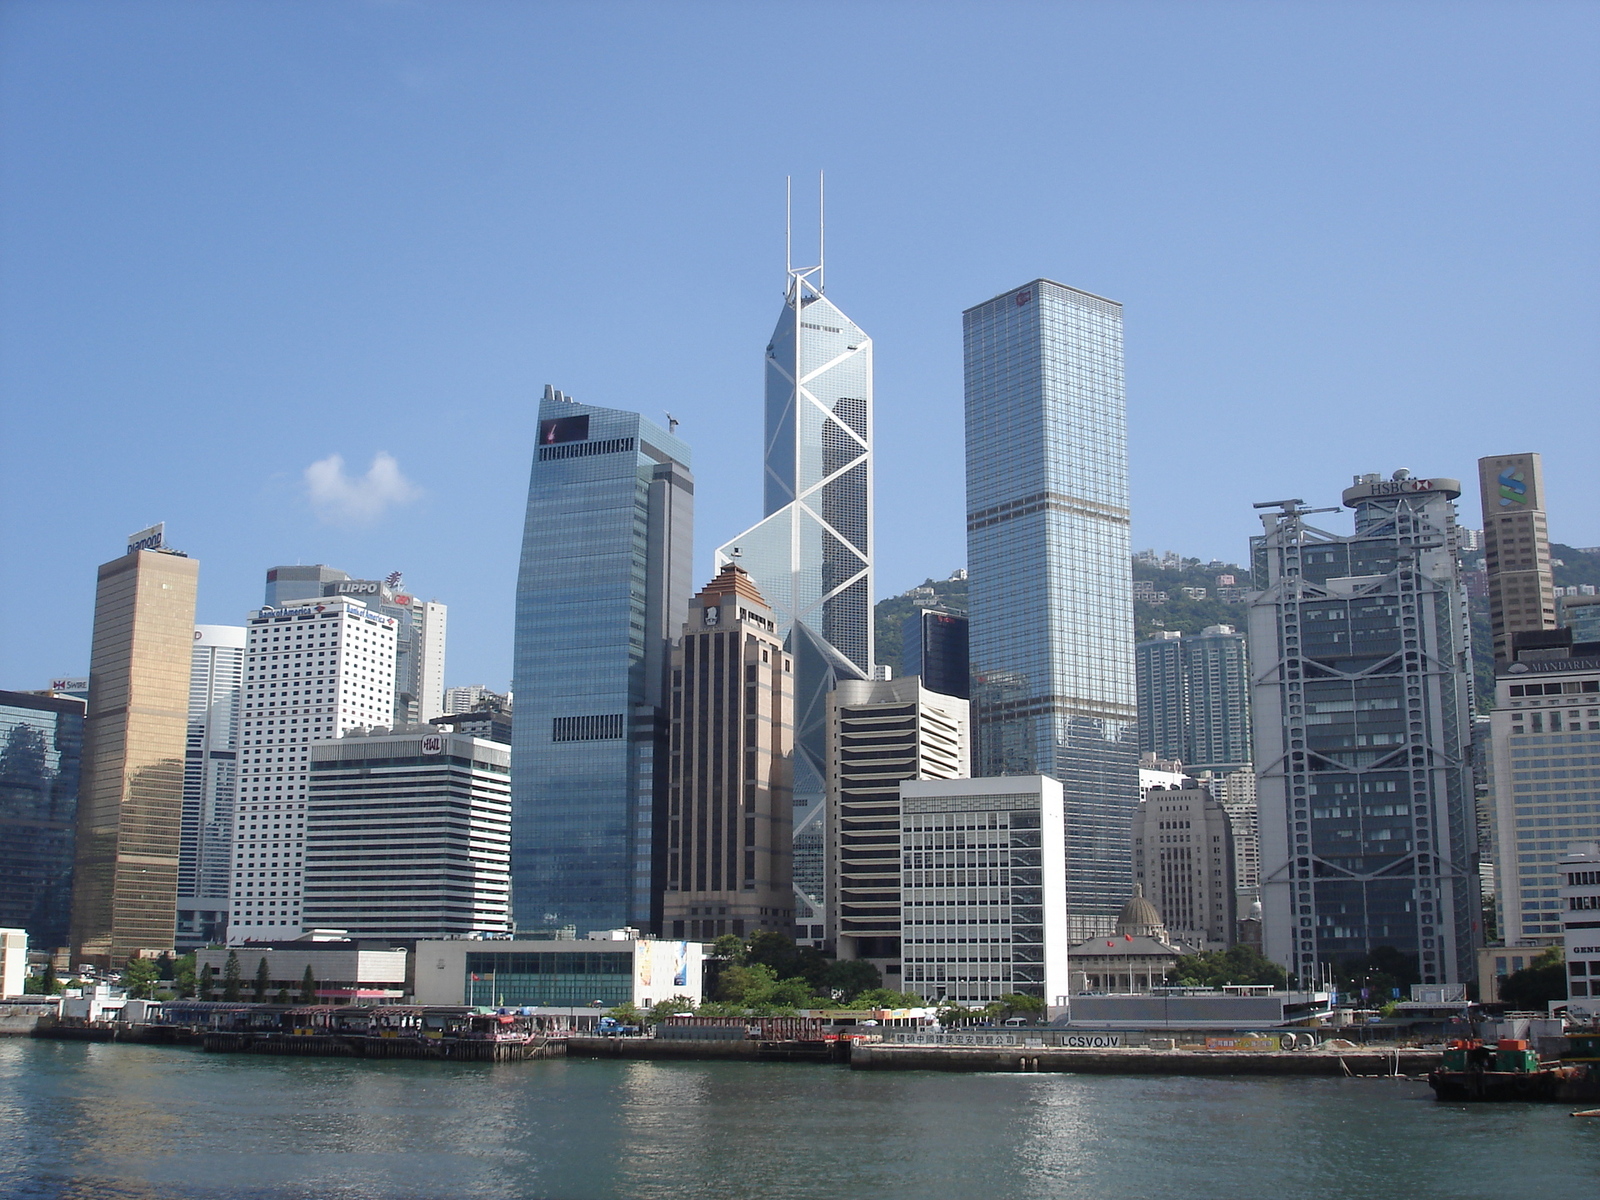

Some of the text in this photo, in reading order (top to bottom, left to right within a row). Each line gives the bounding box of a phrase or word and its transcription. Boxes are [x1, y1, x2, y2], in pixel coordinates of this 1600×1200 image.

[1371, 481, 1409, 495] HSBC
[338, 583, 378, 594] LIPPO
[258, 606, 312, 619] Bank of America
[365, 609, 385, 624] America
[1532, 660, 1593, 672] MANDARIN
[1061, 1036, 1119, 1048] LCSVOJV
